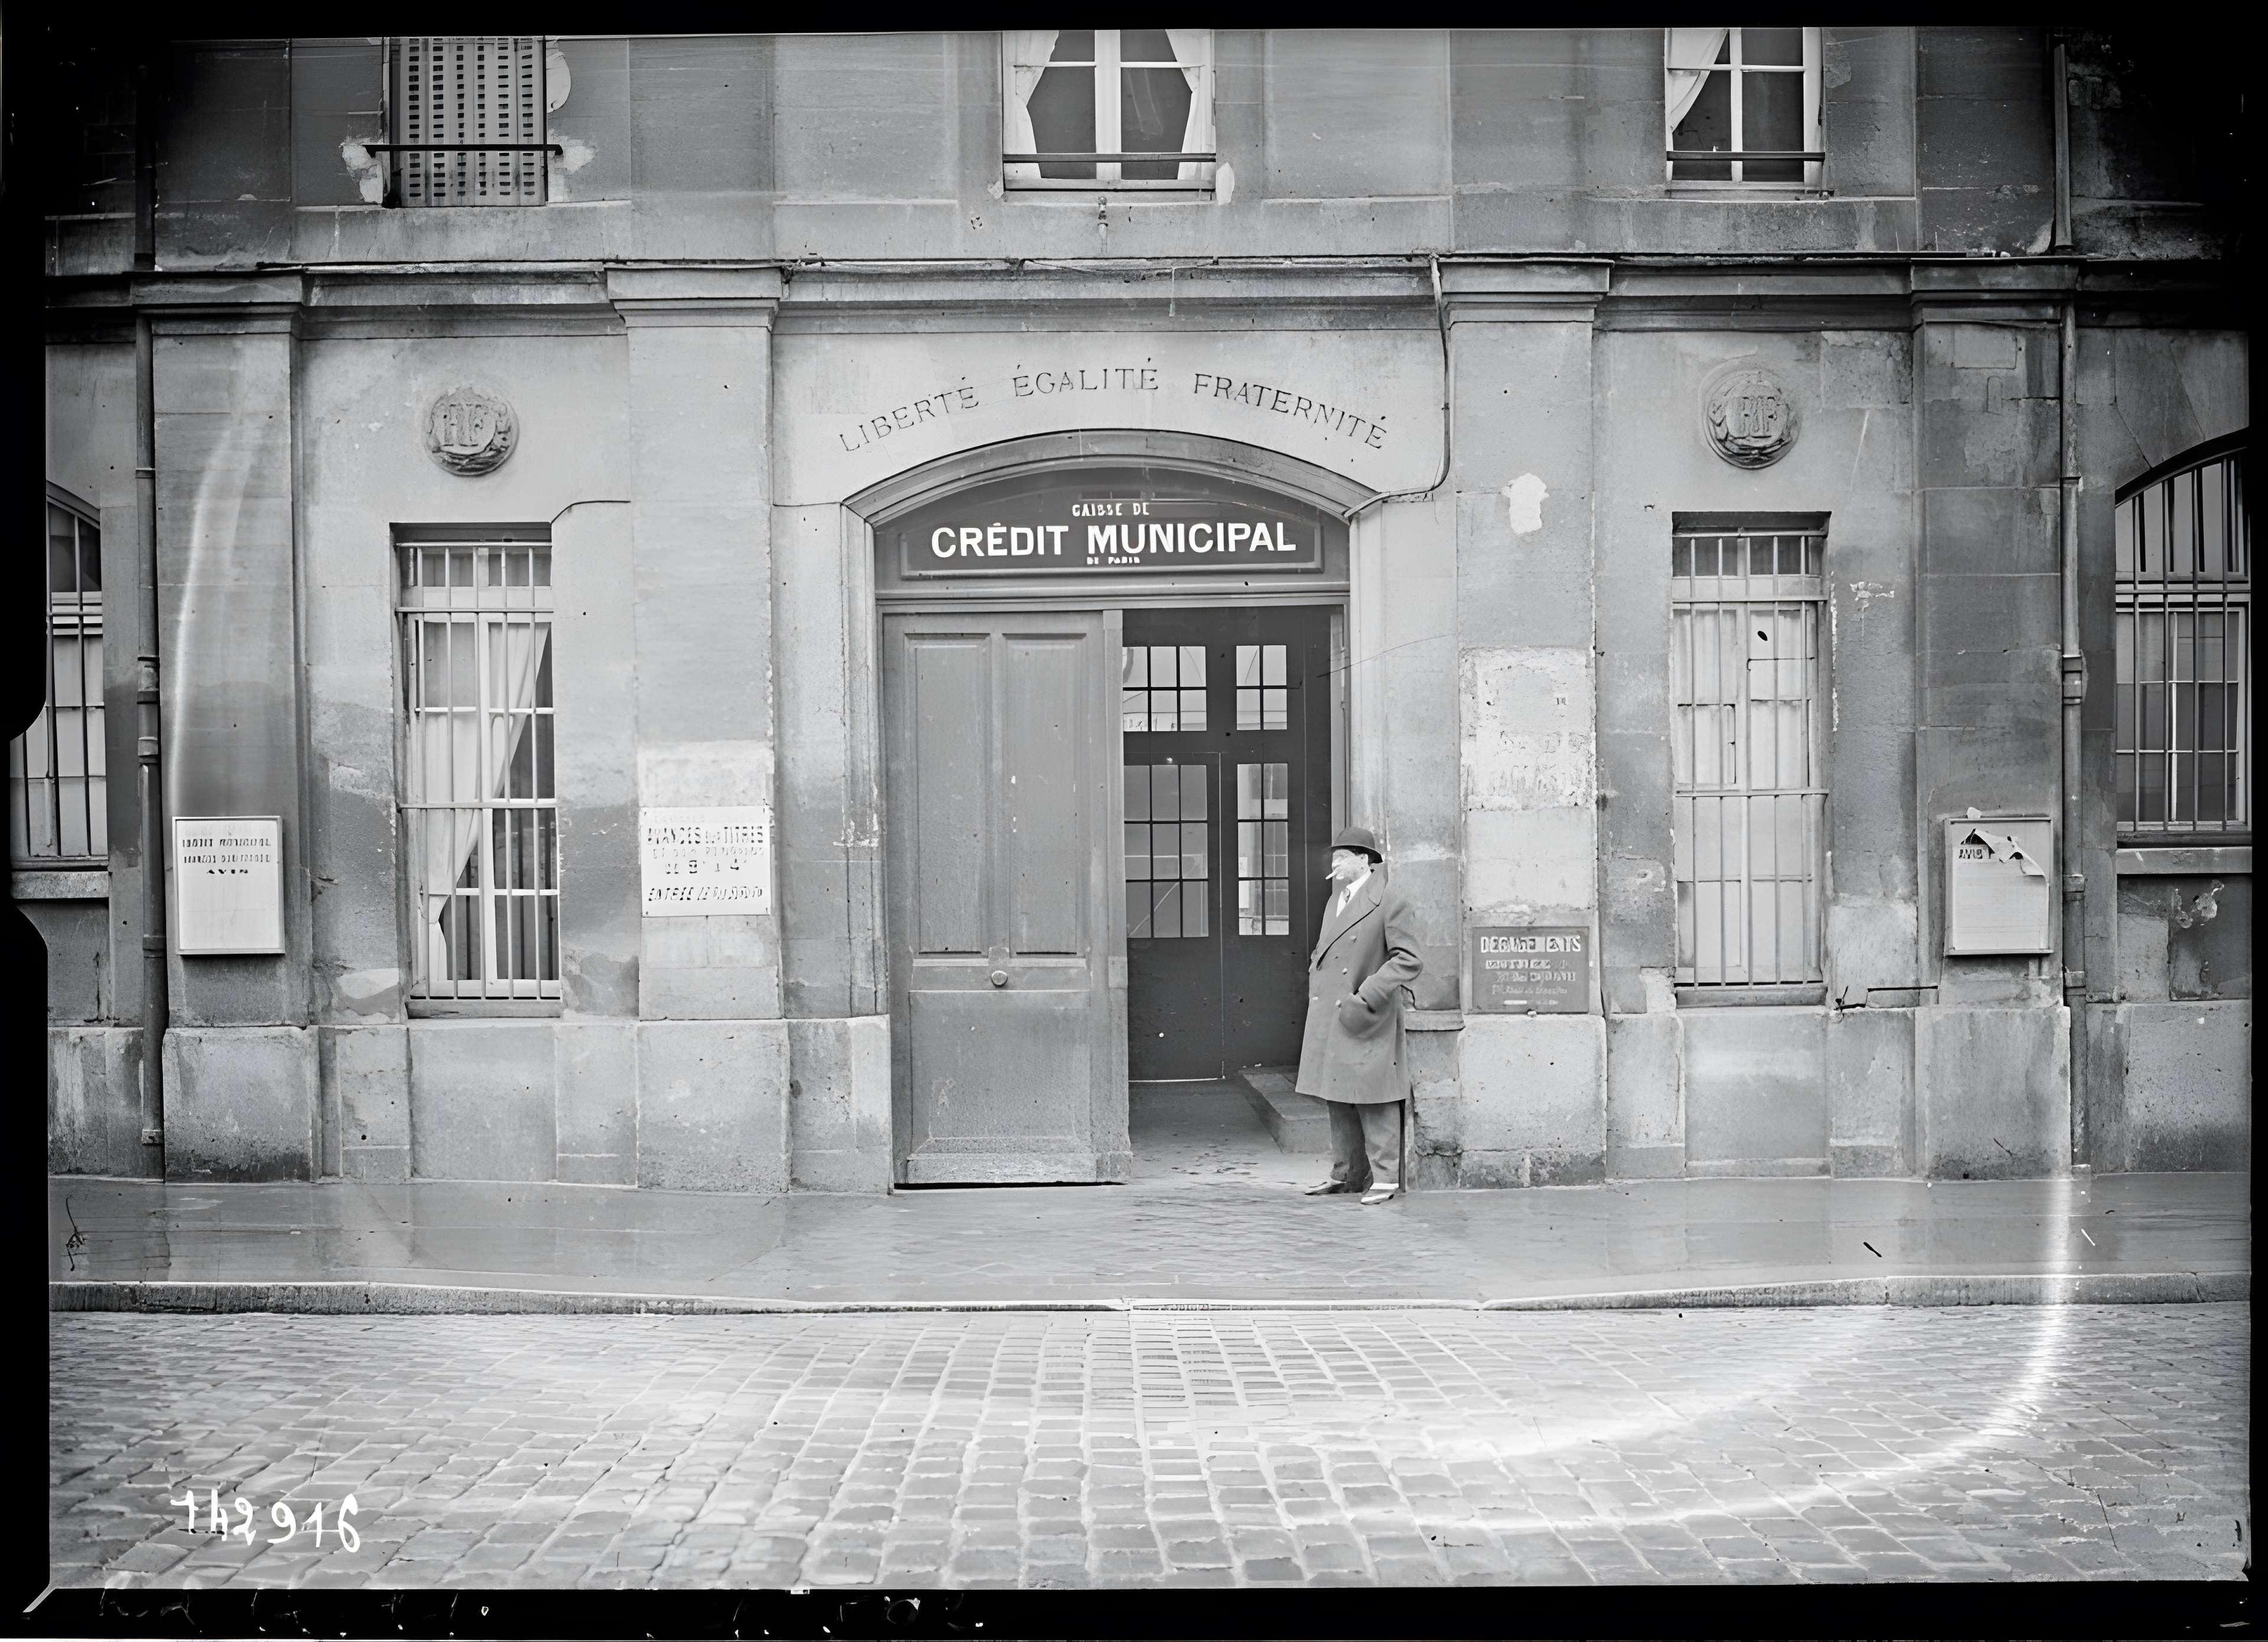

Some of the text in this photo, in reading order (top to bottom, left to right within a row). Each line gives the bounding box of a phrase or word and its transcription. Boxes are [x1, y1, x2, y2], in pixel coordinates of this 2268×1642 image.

[839, 357, 1387, 452] LIBERTÉ ÉGALITÉ FRATERNITÉ
[931, 522, 1296, 558] CRÉDIT MUNICIPAL
